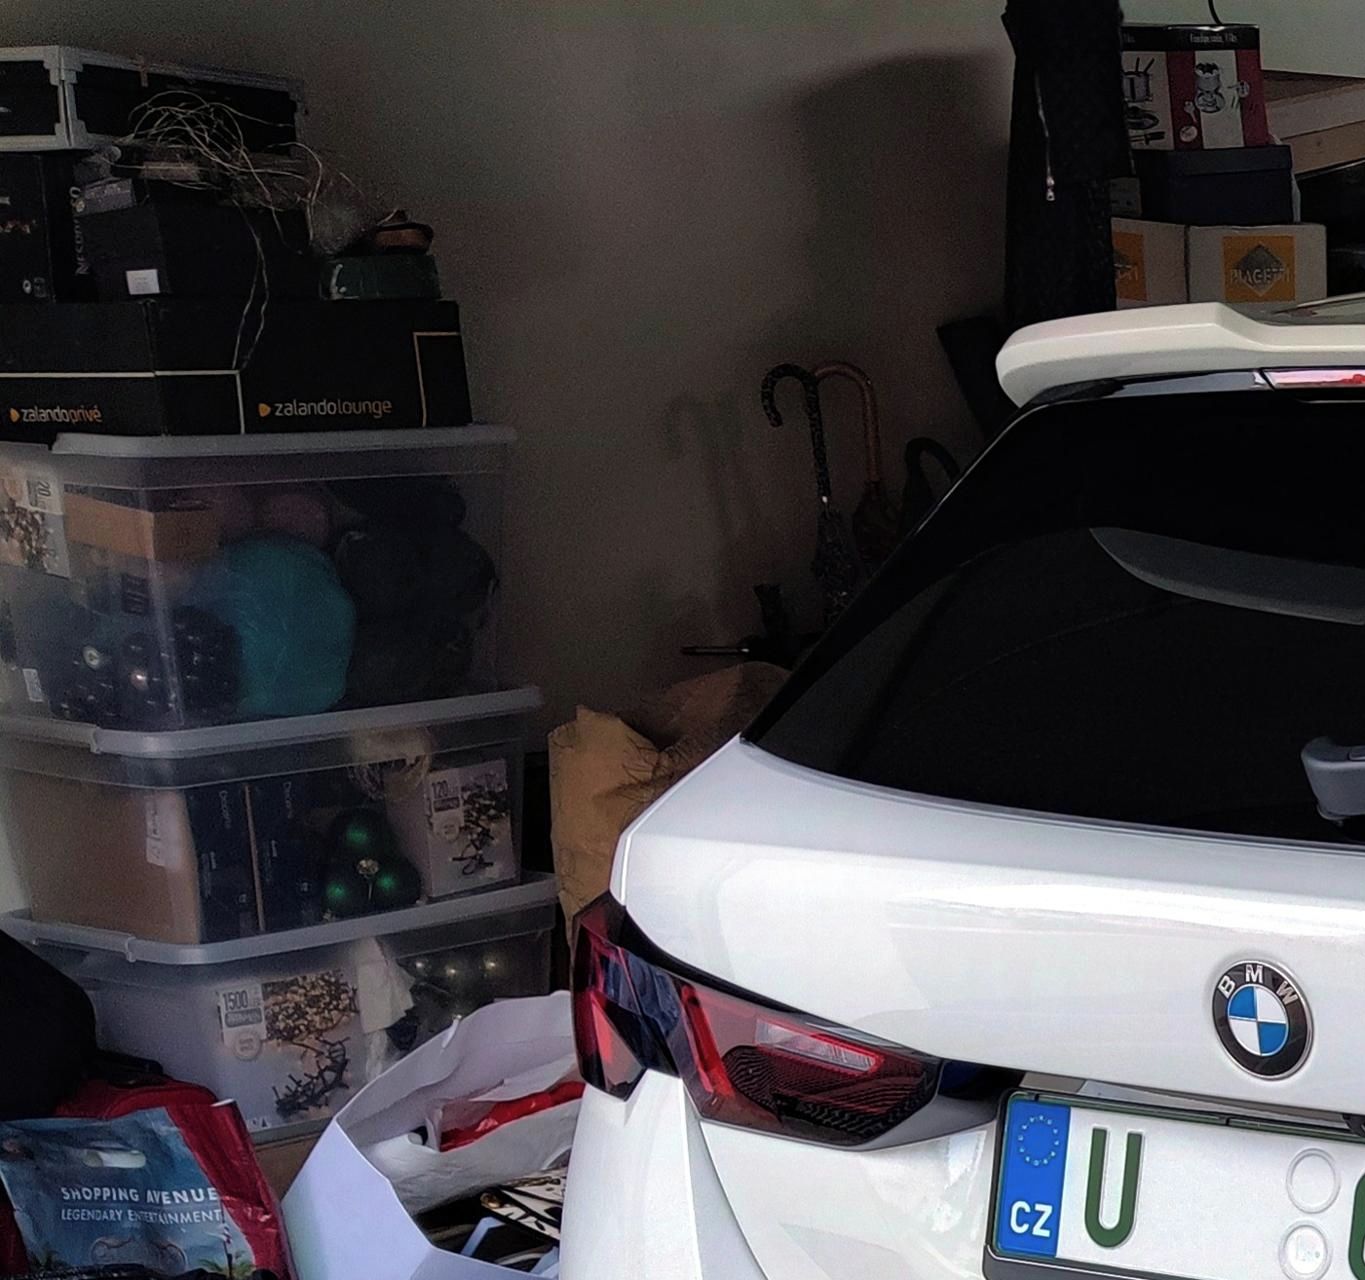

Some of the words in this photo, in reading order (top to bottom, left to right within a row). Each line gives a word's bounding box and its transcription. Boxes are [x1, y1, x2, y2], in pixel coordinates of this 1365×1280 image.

[274, 399, 393, 419] zalandolounge
[1217, 963, 1299, 1006] BMW
[222, 989, 249, 1012] 1500
[61, 1187, 139, 1201] SHOPPING
[146, 1187, 218, 1205] AVENUE
[1084, 1127, 1143, 1249] U
[61, 1208, 123, 1221] LEGENDARY
[128, 1208, 223, 1225] ENTERTAINMENT
[1009, 1199, 1052, 1239] CZ
